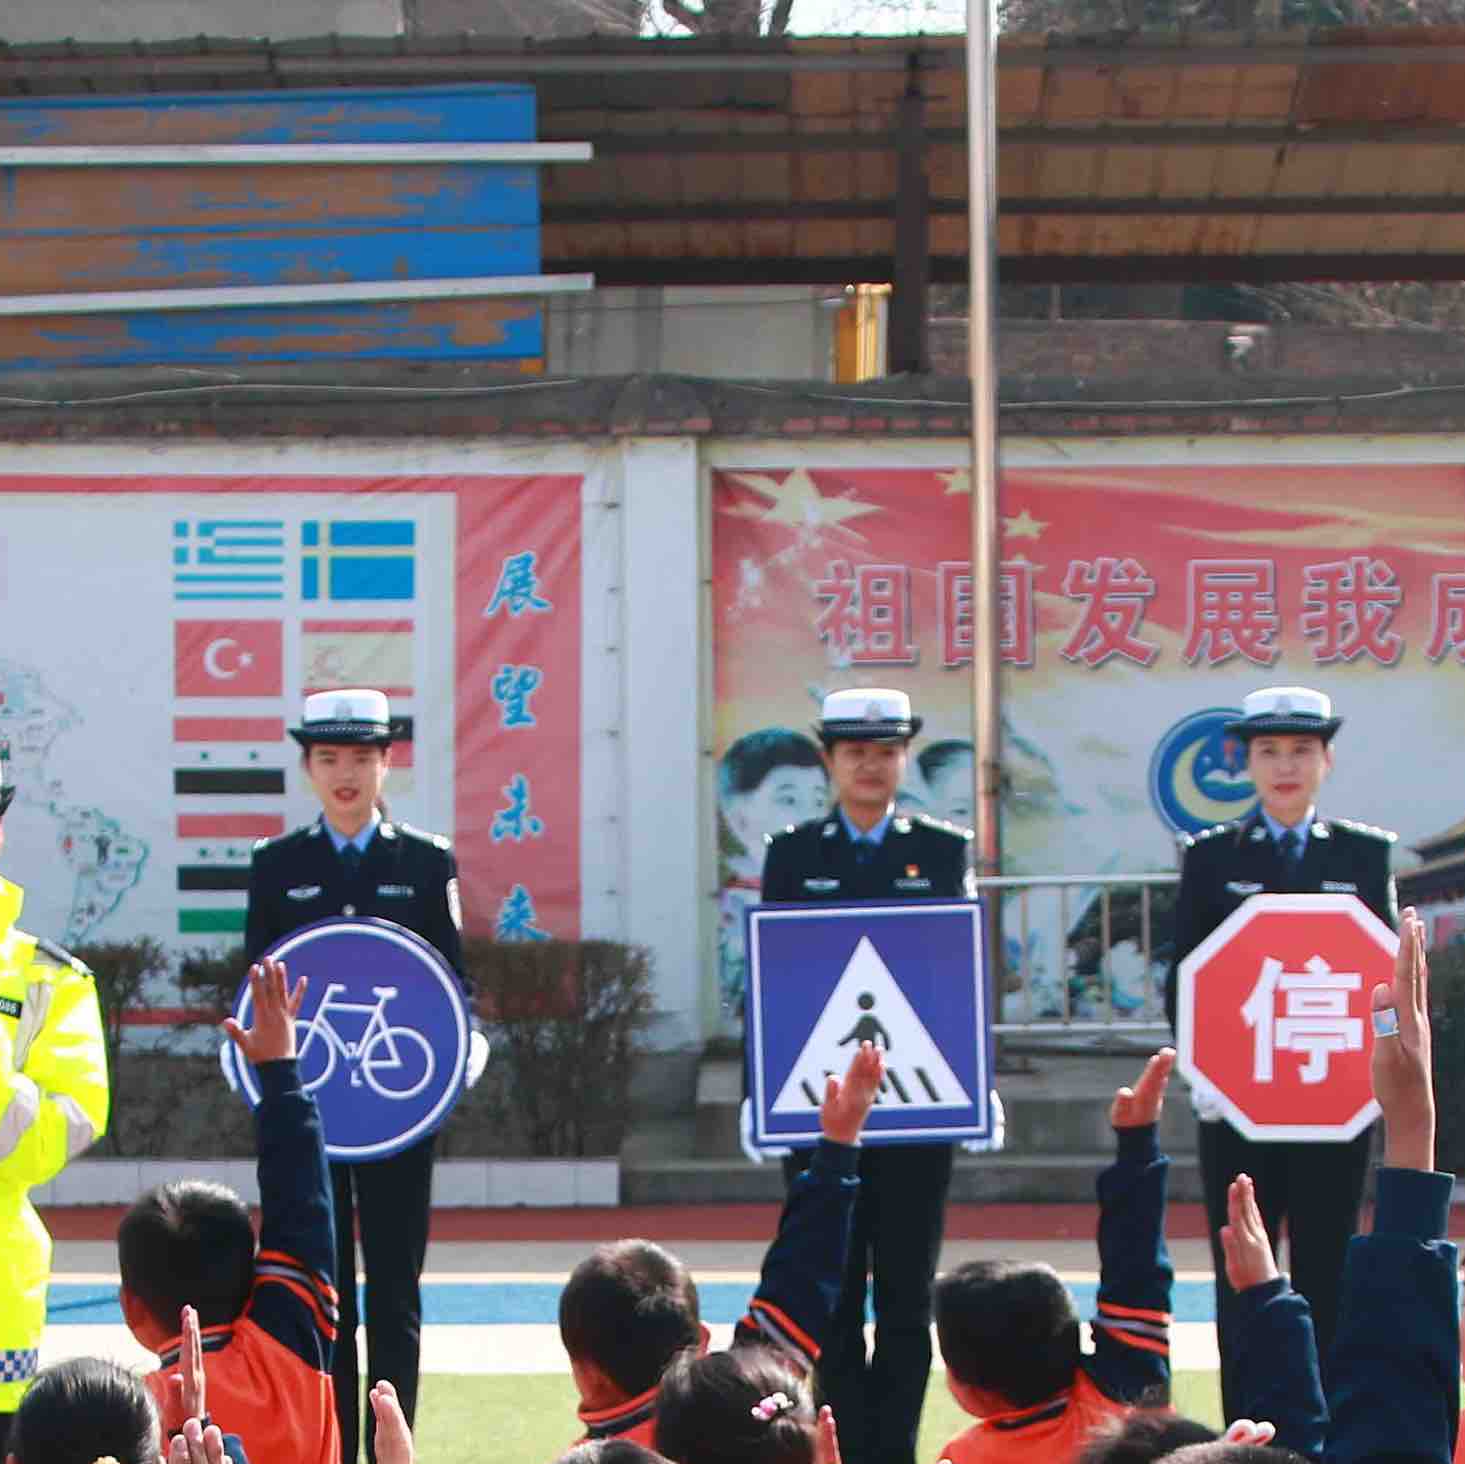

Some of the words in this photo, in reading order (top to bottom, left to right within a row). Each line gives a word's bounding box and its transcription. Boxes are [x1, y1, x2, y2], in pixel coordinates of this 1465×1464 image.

[486, 549, 555, 942] 展望未来
[1239, 955, 1364, 1086] 停
